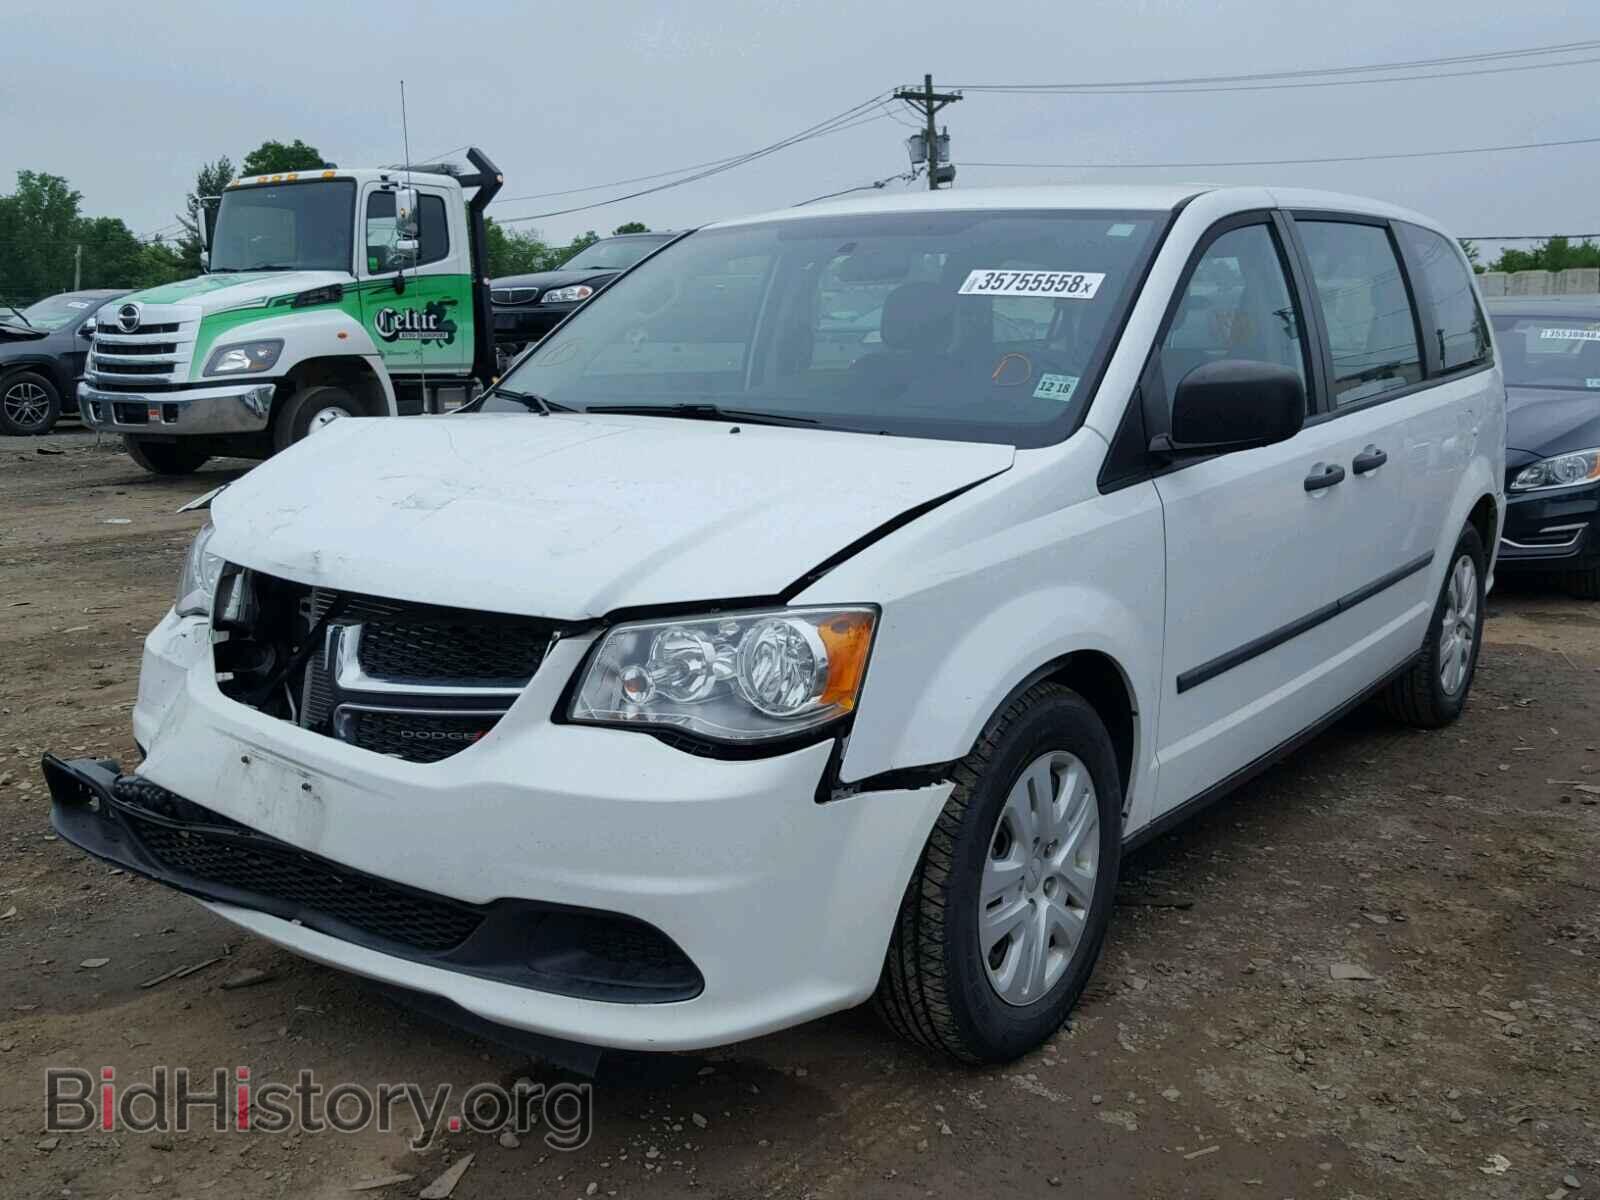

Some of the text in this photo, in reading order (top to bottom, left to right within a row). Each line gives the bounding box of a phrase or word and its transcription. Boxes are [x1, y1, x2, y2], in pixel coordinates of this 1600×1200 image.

[374, 307, 438, 337] Celtic
[1039, 381, 1071, 394] 12 18
[401, 730, 477, 740] DODGE
